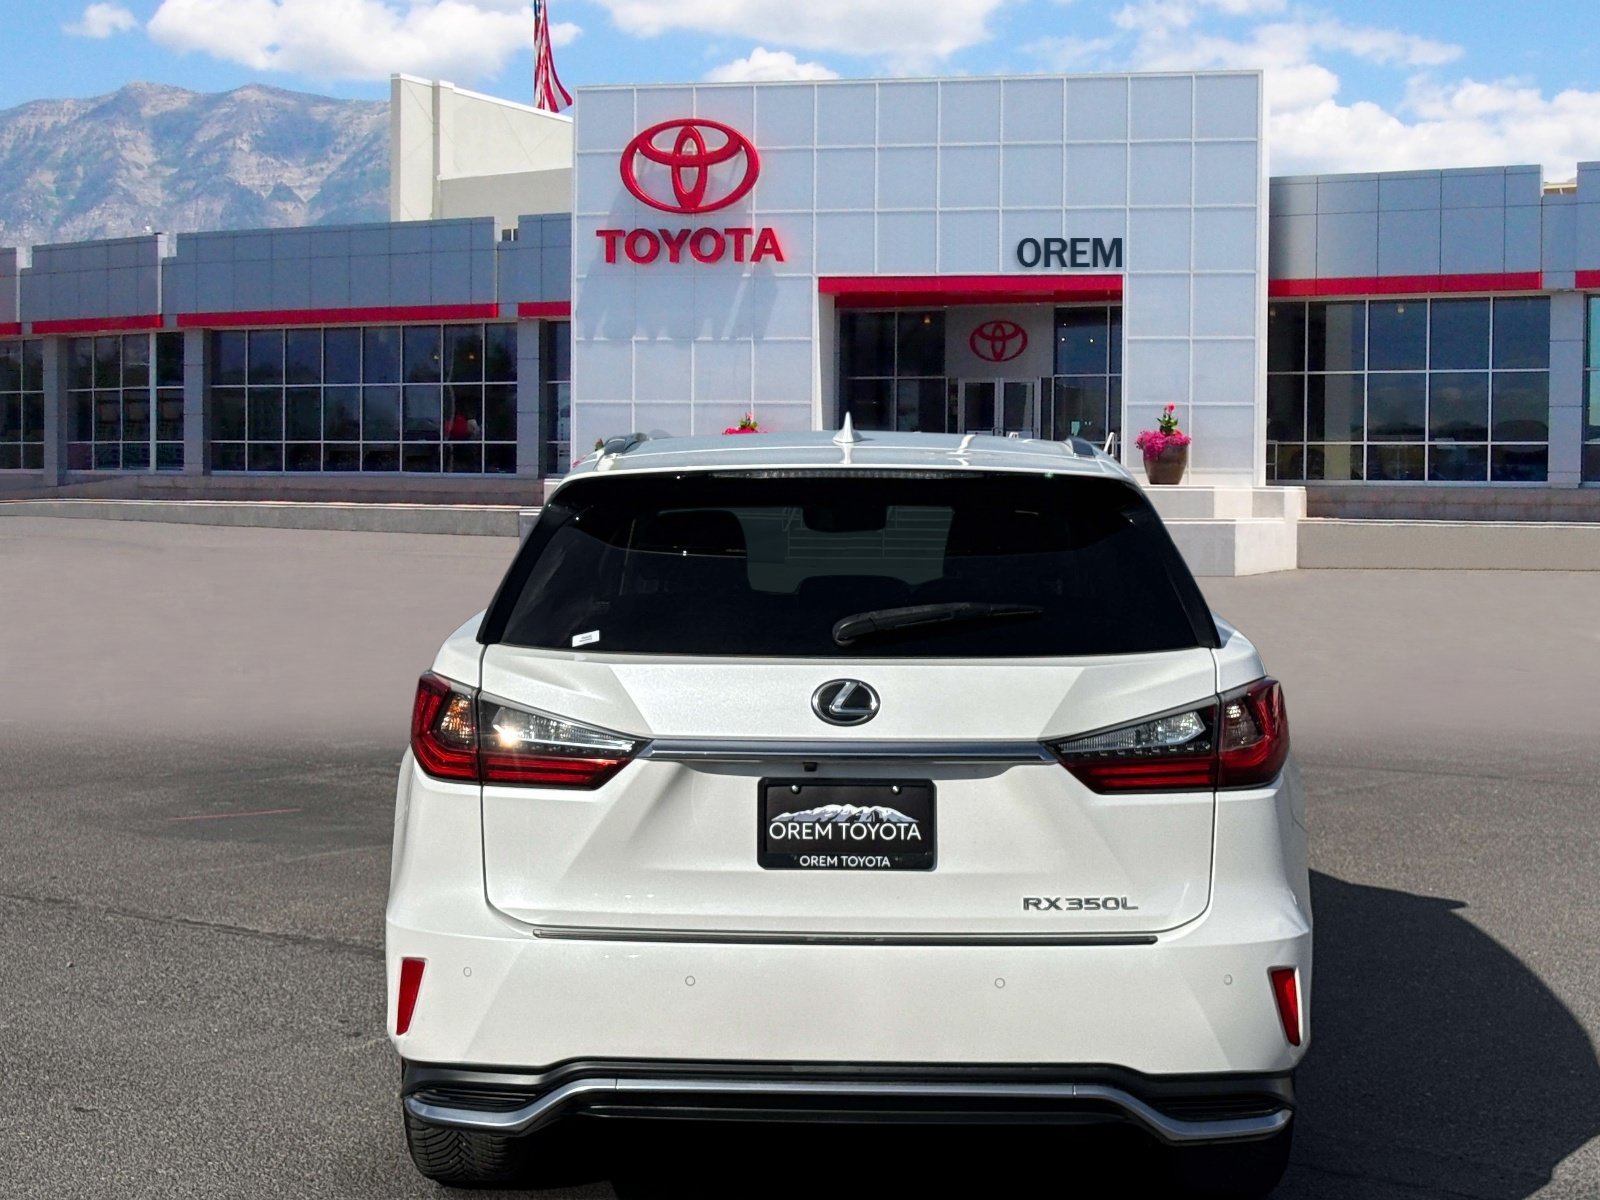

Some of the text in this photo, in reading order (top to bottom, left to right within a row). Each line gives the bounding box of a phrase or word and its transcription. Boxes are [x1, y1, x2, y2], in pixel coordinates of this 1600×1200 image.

[596, 227, 785, 264] TOYOTA
[1016, 237, 1123, 268] OREM
[769, 822, 922, 841] OREM TOYOTA
[800, 855, 891, 868] OREM TOYOTA
